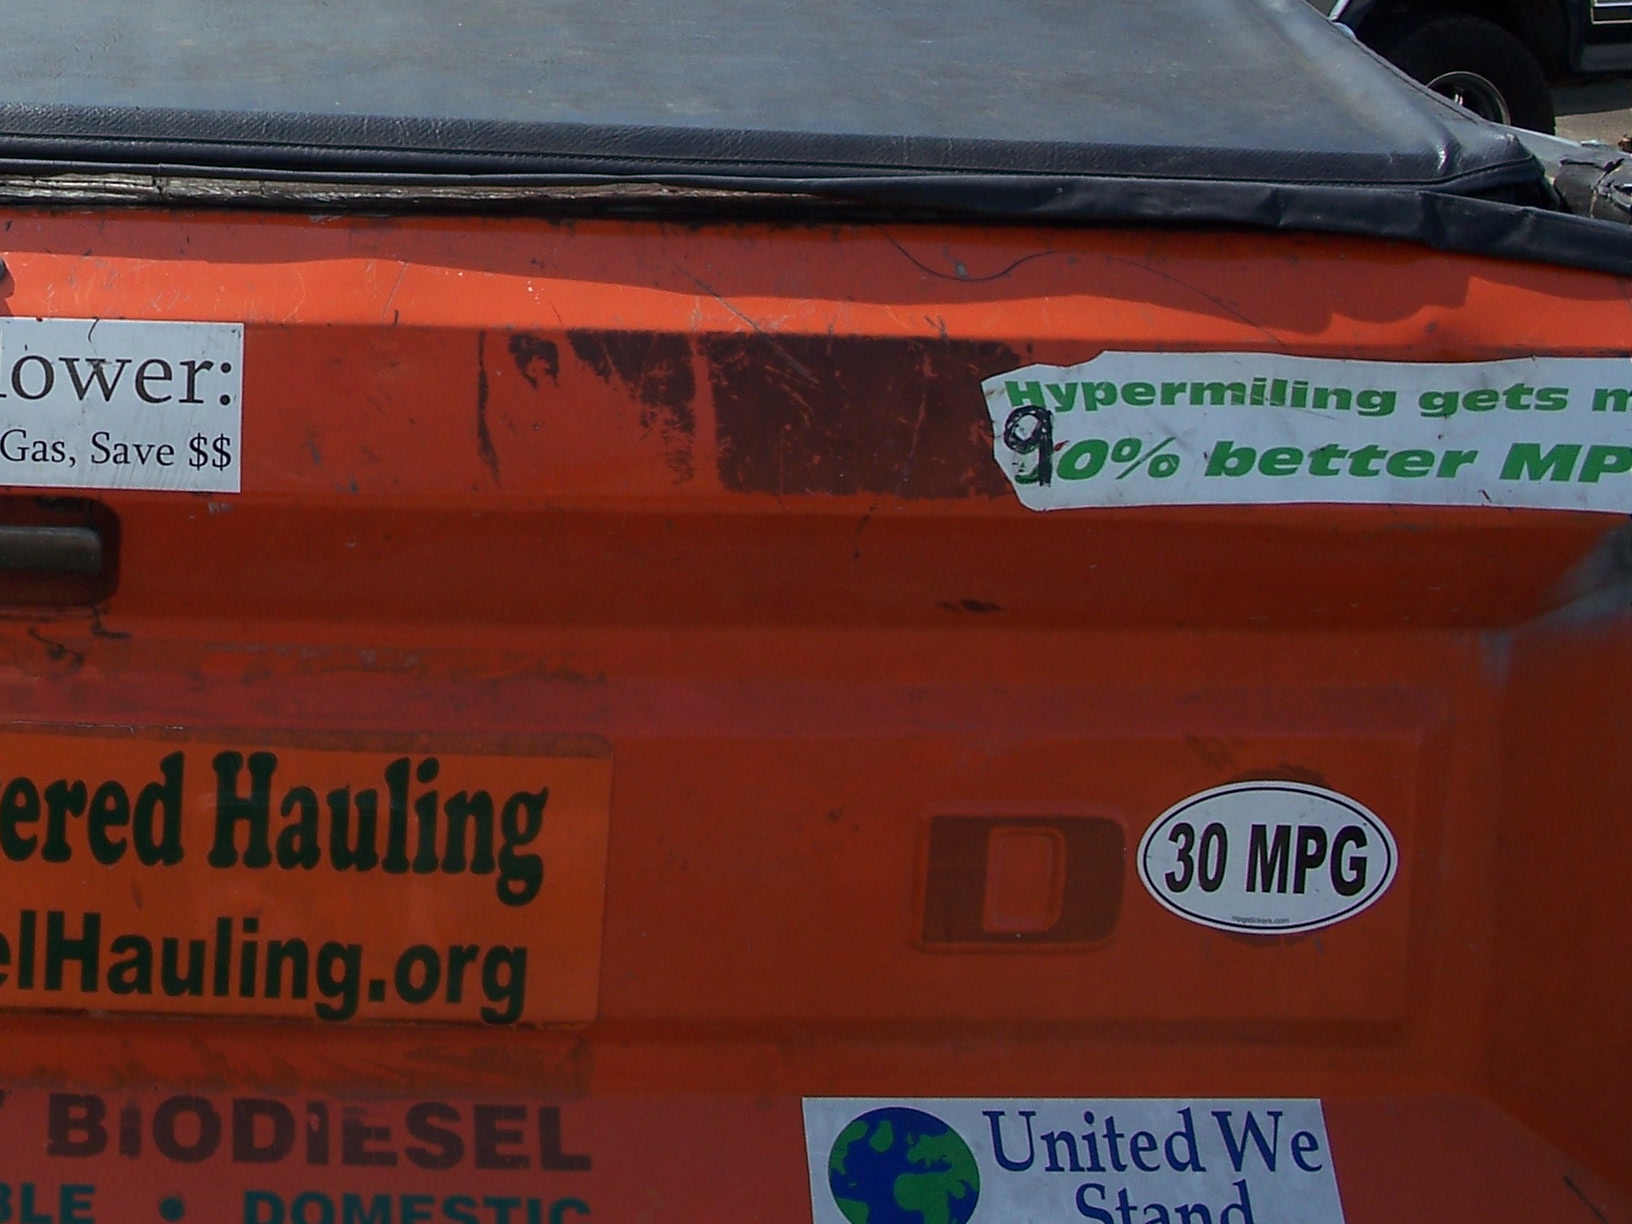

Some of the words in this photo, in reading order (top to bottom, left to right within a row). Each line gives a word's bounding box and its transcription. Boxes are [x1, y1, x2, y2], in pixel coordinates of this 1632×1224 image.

[1004, 376, 1397, 418] Hypermiling
[1417, 382, 1569, 419] gets
[0, 429, 78, 468] Gas,
[90, 432, 175, 467] Save
[187, 433, 233, 471] $$
[1204, 440, 1479, 479] better
[207, 750, 548, 907] Hauling
[1164, 822, 1227, 893] 30
[1245, 823, 1369, 897] MPG
[46, 1092, 593, 1172] BIODIESEL
[982, 1107, 1206, 1174] United
[1211, 1109, 1323, 1173] We
